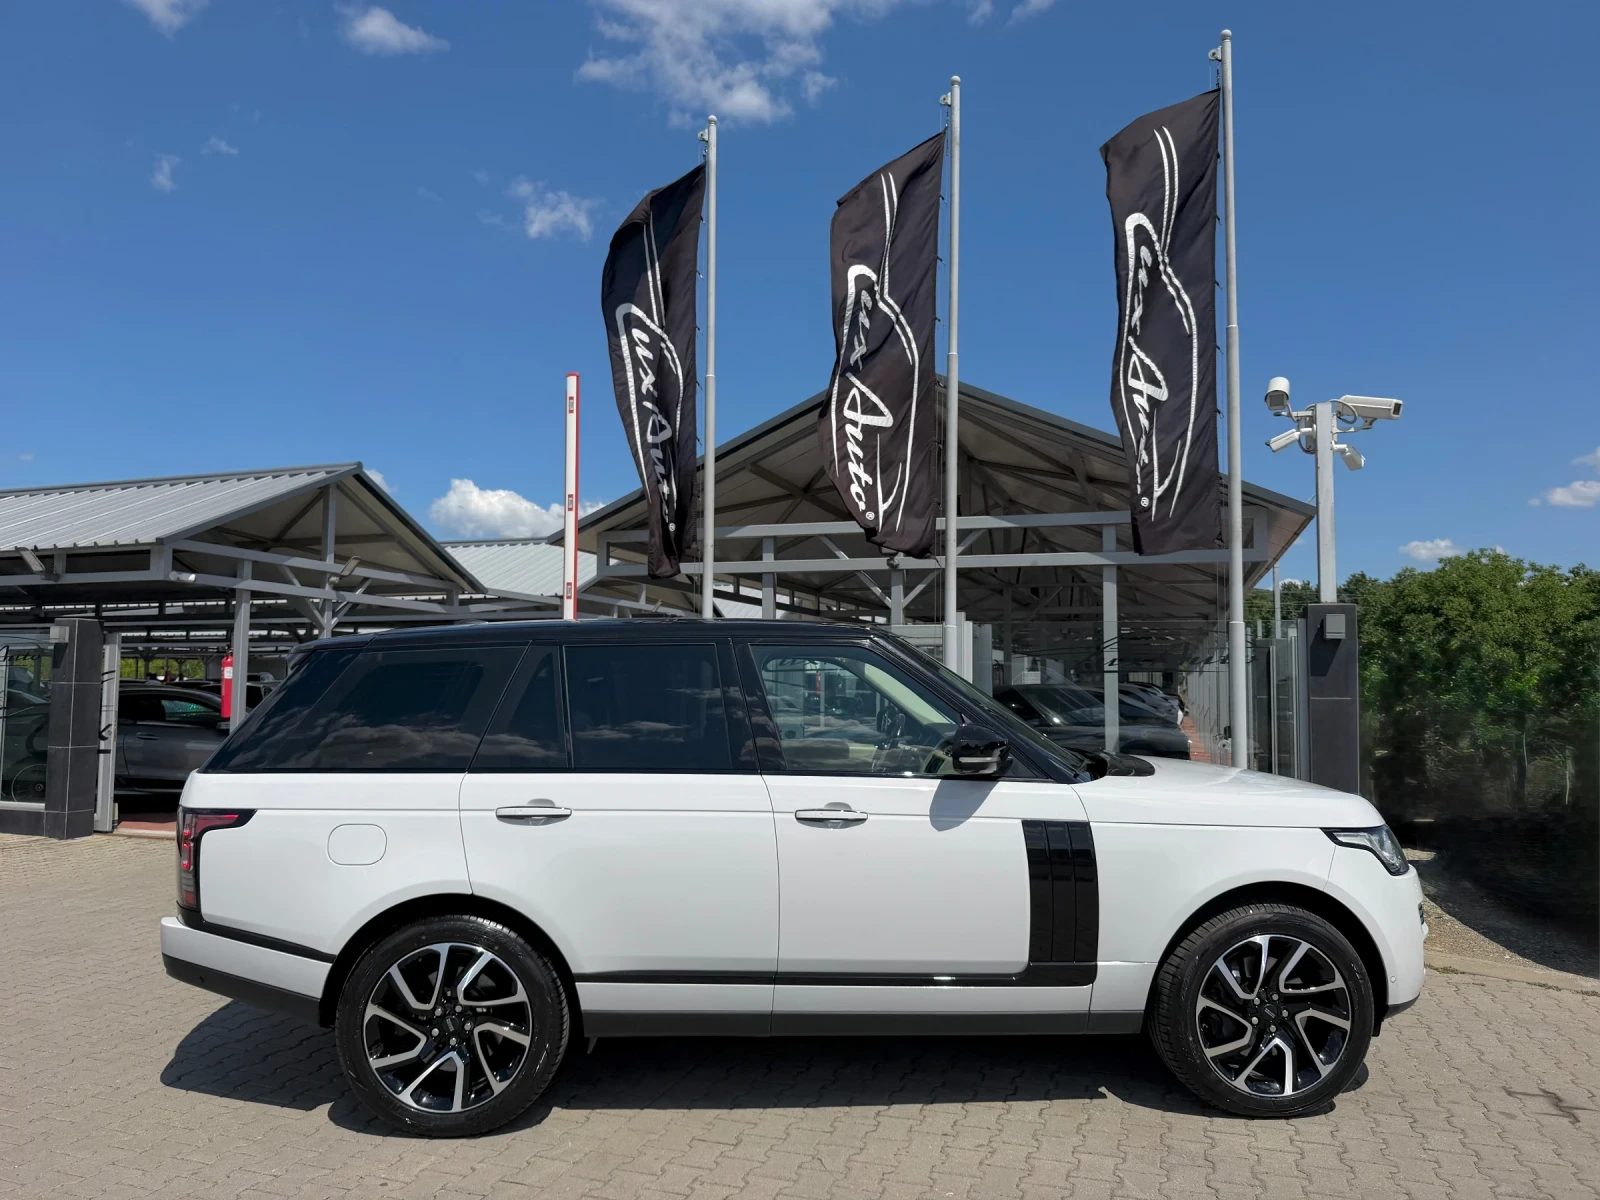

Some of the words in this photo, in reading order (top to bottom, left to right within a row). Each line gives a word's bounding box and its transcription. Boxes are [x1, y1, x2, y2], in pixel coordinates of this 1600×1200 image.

[847, 264, 878, 371] Lux
[615, 302, 662, 399] Lux
[642, 400, 672, 524] Auto
[843, 371, 893, 512] Auto
